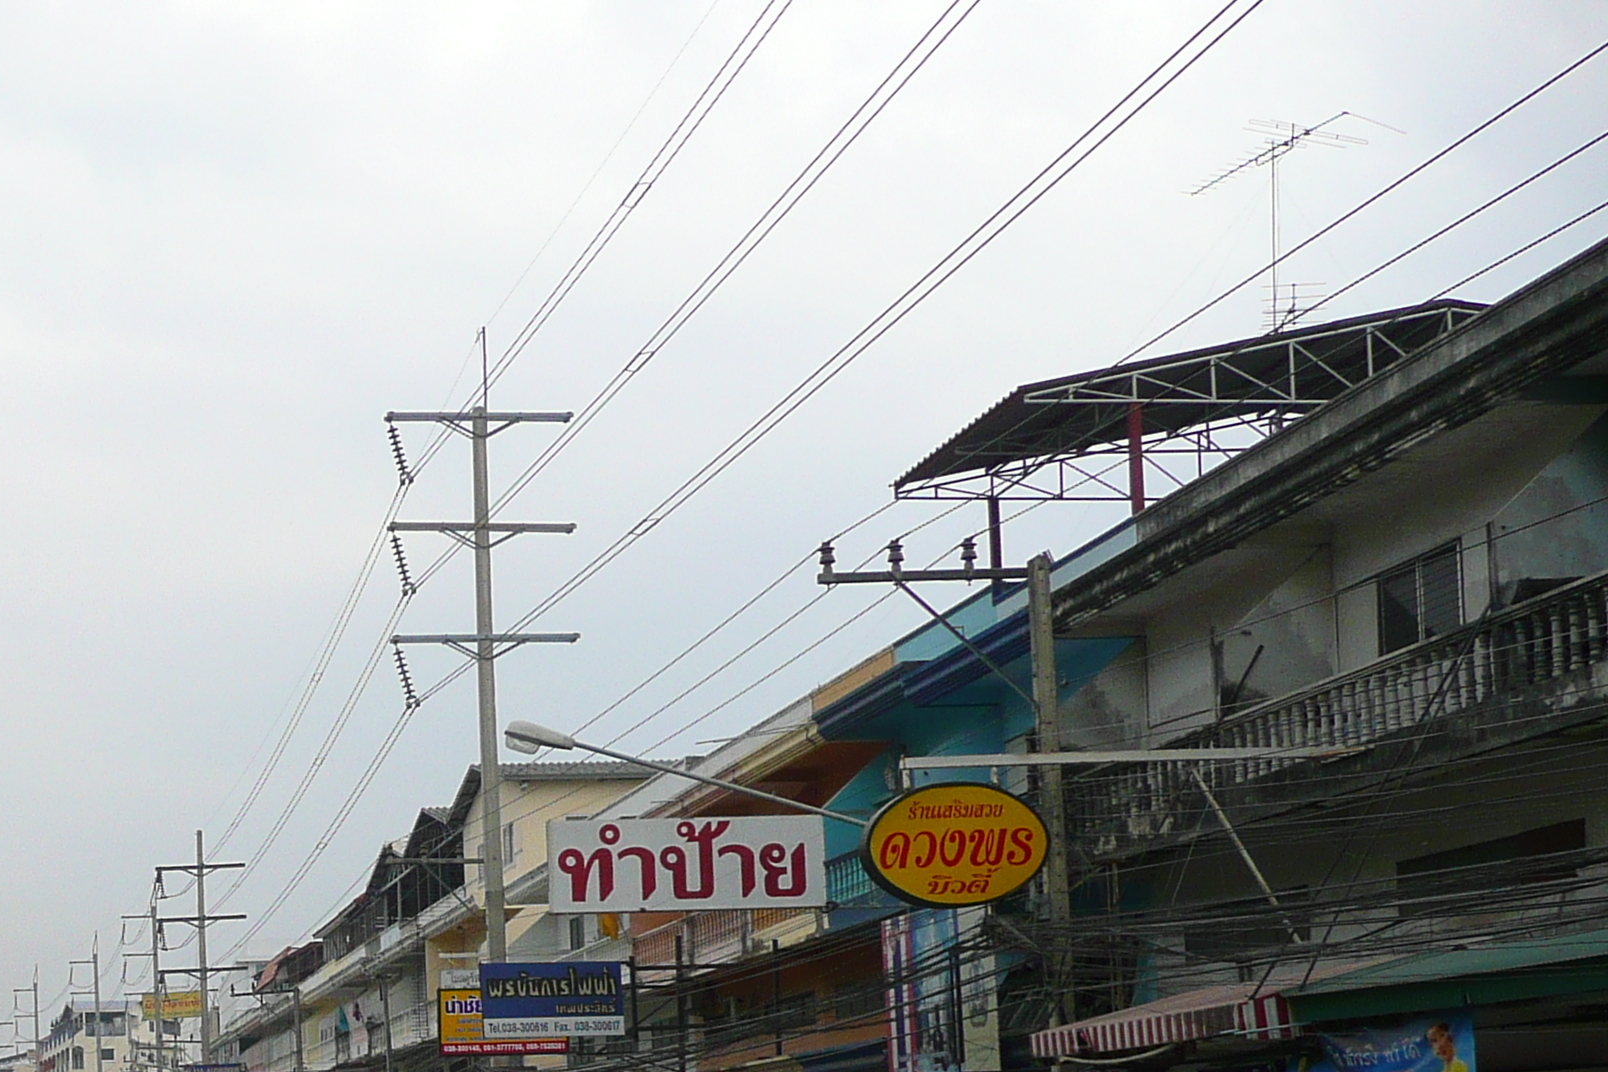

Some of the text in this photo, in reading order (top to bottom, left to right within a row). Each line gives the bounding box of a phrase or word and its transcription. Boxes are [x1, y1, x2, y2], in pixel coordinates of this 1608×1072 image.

[908, 799, 1004, 820] ร้านเสริมสวย
[558, 821, 807, 902] ทำป้าย
[879, 827, 1034, 870] ดวงพร
